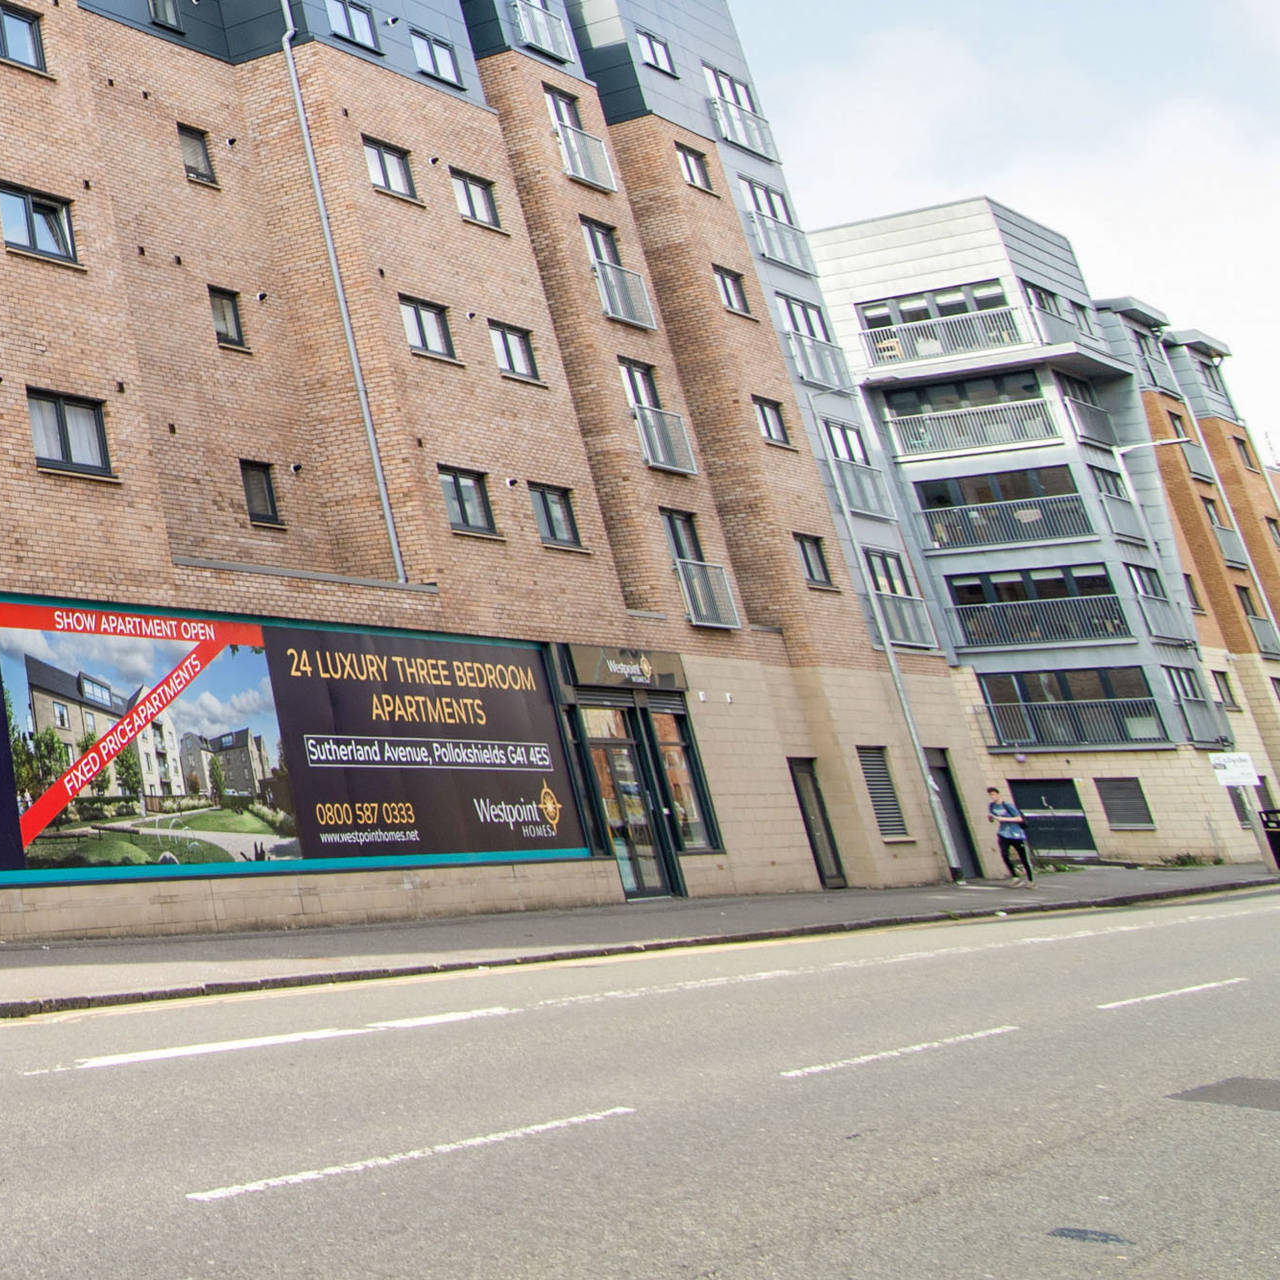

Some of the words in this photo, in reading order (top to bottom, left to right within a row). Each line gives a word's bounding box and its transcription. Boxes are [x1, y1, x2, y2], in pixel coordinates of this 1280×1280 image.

[53, 610, 96, 630] SHOW
[100, 615, 177, 638] APARTMENT
[181, 622, 216, 641] OPEN
[286, 648, 312, 677] 24
[315, 650, 388, 681] LUXURY
[391, 656, 451, 687] THREE
[452, 660, 537, 691] BEDROOM
[63, 752, 100, 797] FIXED
[99, 718, 134, 762] PRICE
[132, 653, 201, 733] APARTMENTS
[371, 693, 487, 726] APARTMENTS
[307, 739, 381, 762] Sutherland
[384, 742, 433, 766] Avenue,
[432, 743, 506, 765] Pollokshields
[507, 745, 528, 765] G41
[529, 745, 550, 766] 4ES
[316, 803, 353, 825] 0800
[355, 803, 379, 824] 587
[382, 802, 416, 824] 0333
[473, 797, 541, 831] Westpoint
[320, 828, 420, 846] www.westpointhomes.net
